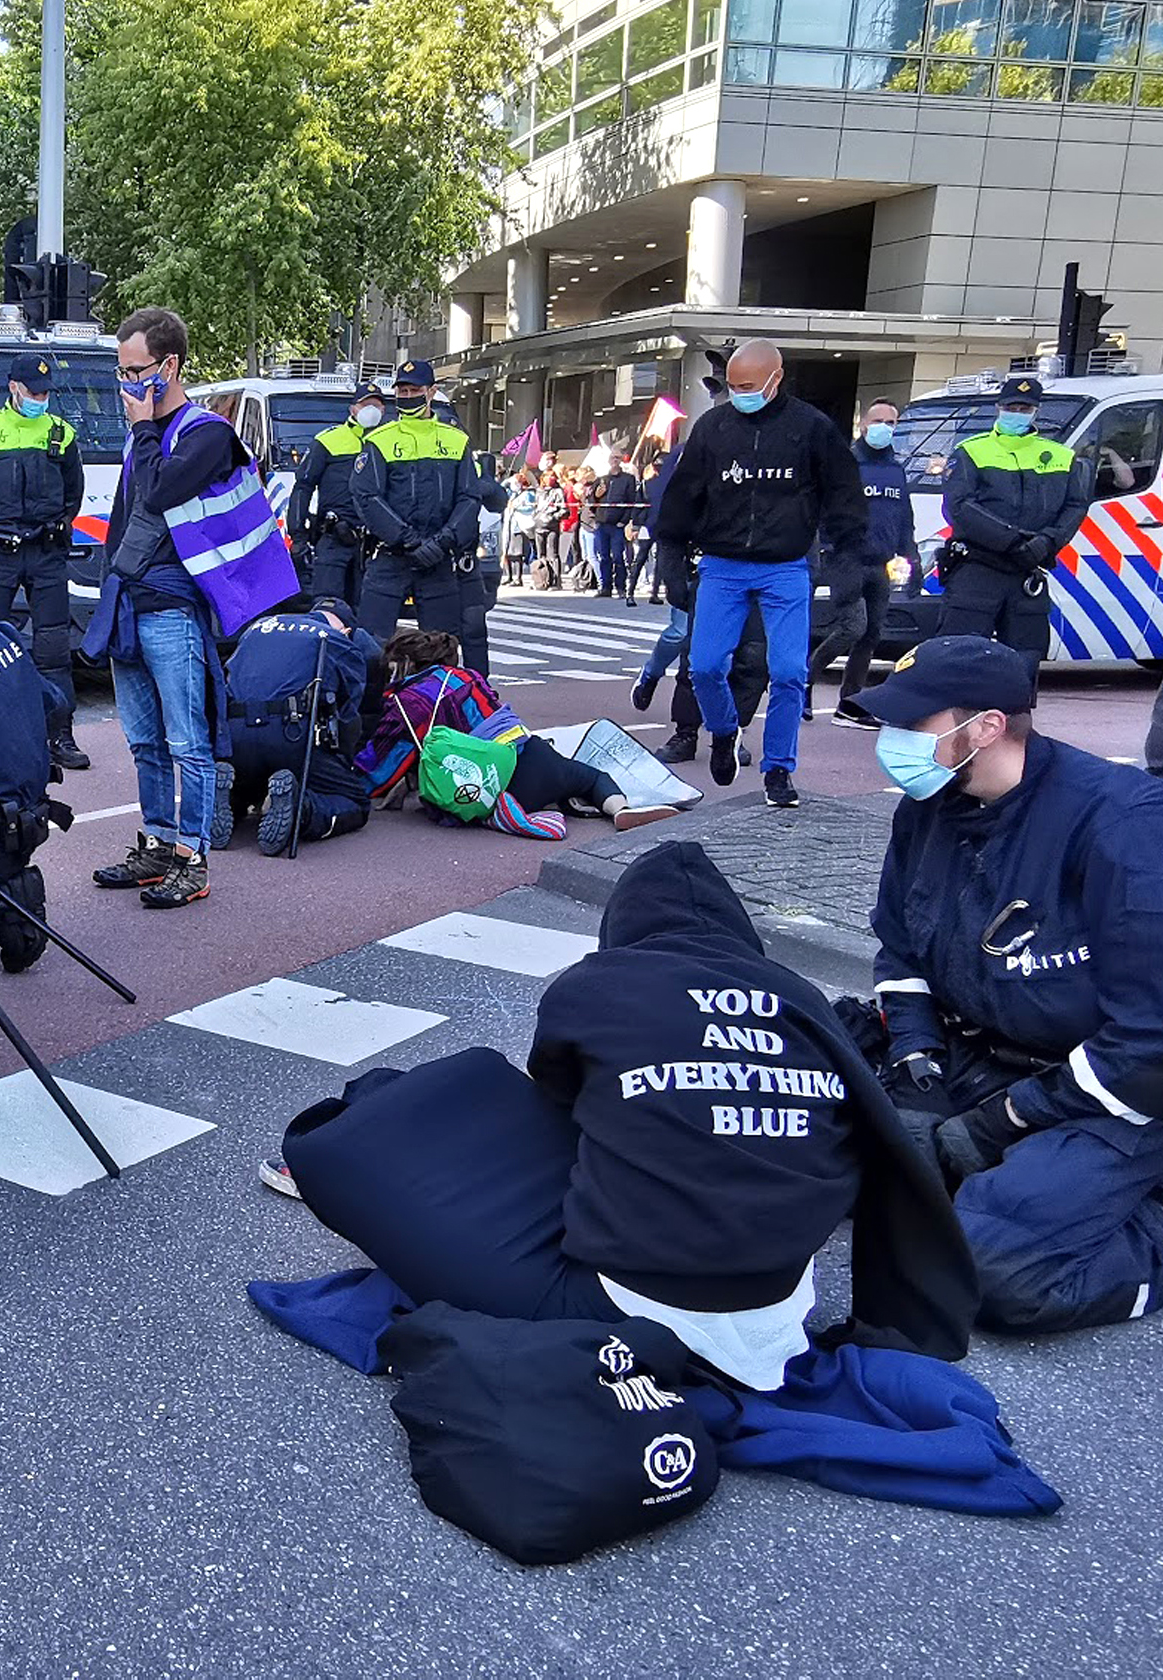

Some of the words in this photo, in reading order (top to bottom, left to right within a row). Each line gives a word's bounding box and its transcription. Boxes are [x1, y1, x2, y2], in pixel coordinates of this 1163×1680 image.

[722, 460, 793, 484] POLITIE
[864, 485, 901, 499] OLITIE
[1006, 945, 1091, 977] POLITIE
[687, 988, 781, 1018] YOU
[702, 1023, 784, 1055] AND
[618, 1061, 846, 1100] EVERYTHING
[711, 1105, 809, 1138] BLUE
[654, 1446, 687, 1475] C&A
